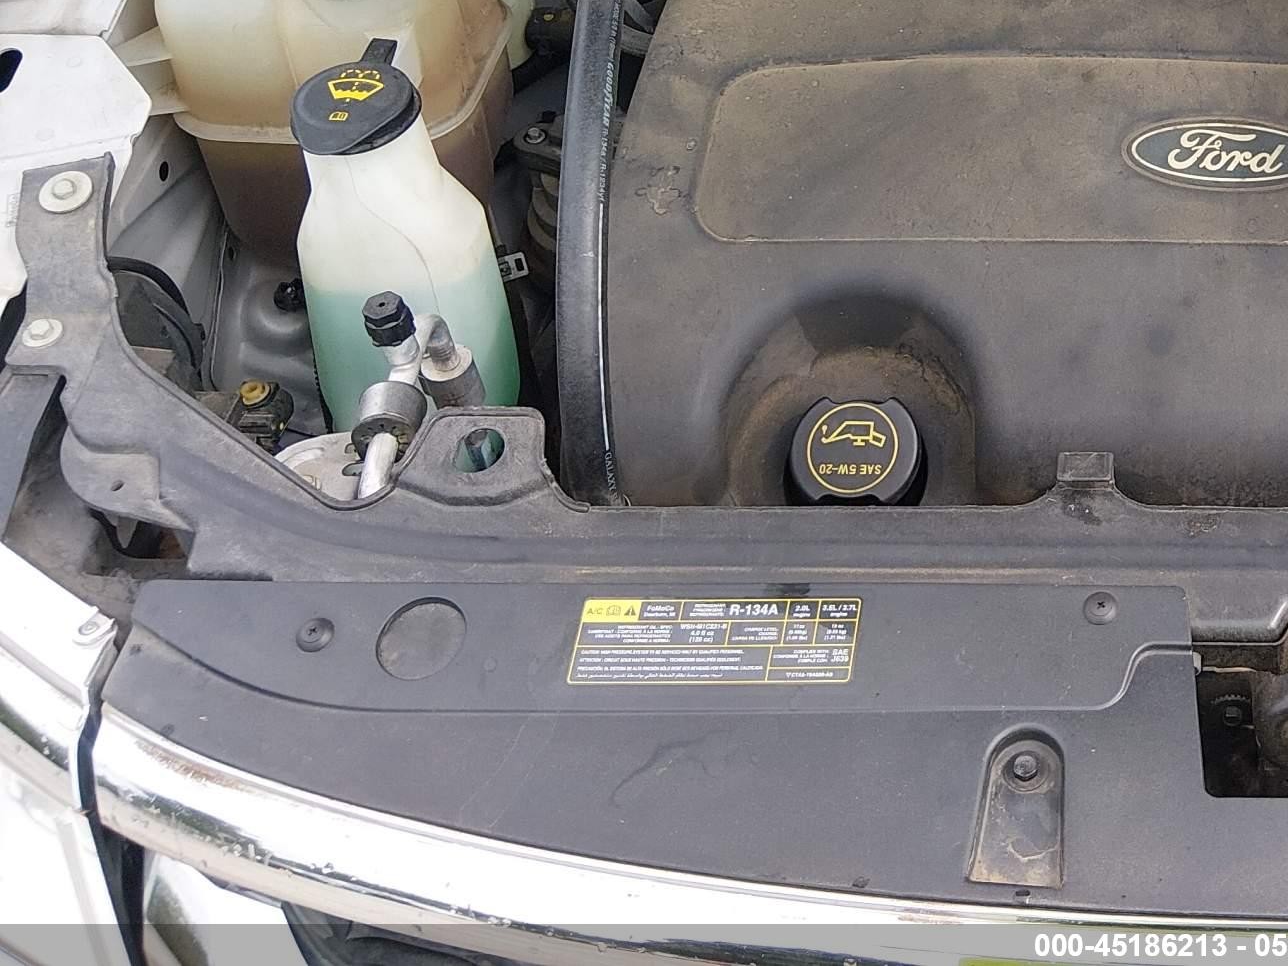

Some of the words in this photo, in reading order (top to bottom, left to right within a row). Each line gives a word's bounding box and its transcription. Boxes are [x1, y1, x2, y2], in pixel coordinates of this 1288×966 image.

[602, 61, 614, 128] GOODYEAR
[1167, 129, 1286, 174] Ford
[605, 452, 616, 491] GALAXY
[819, 463, 857, 475] 5W-20
[859, 464, 882, 474] SAE
[587, 607, 604, 615] A/C
[729, 603, 779, 616] R-134A
